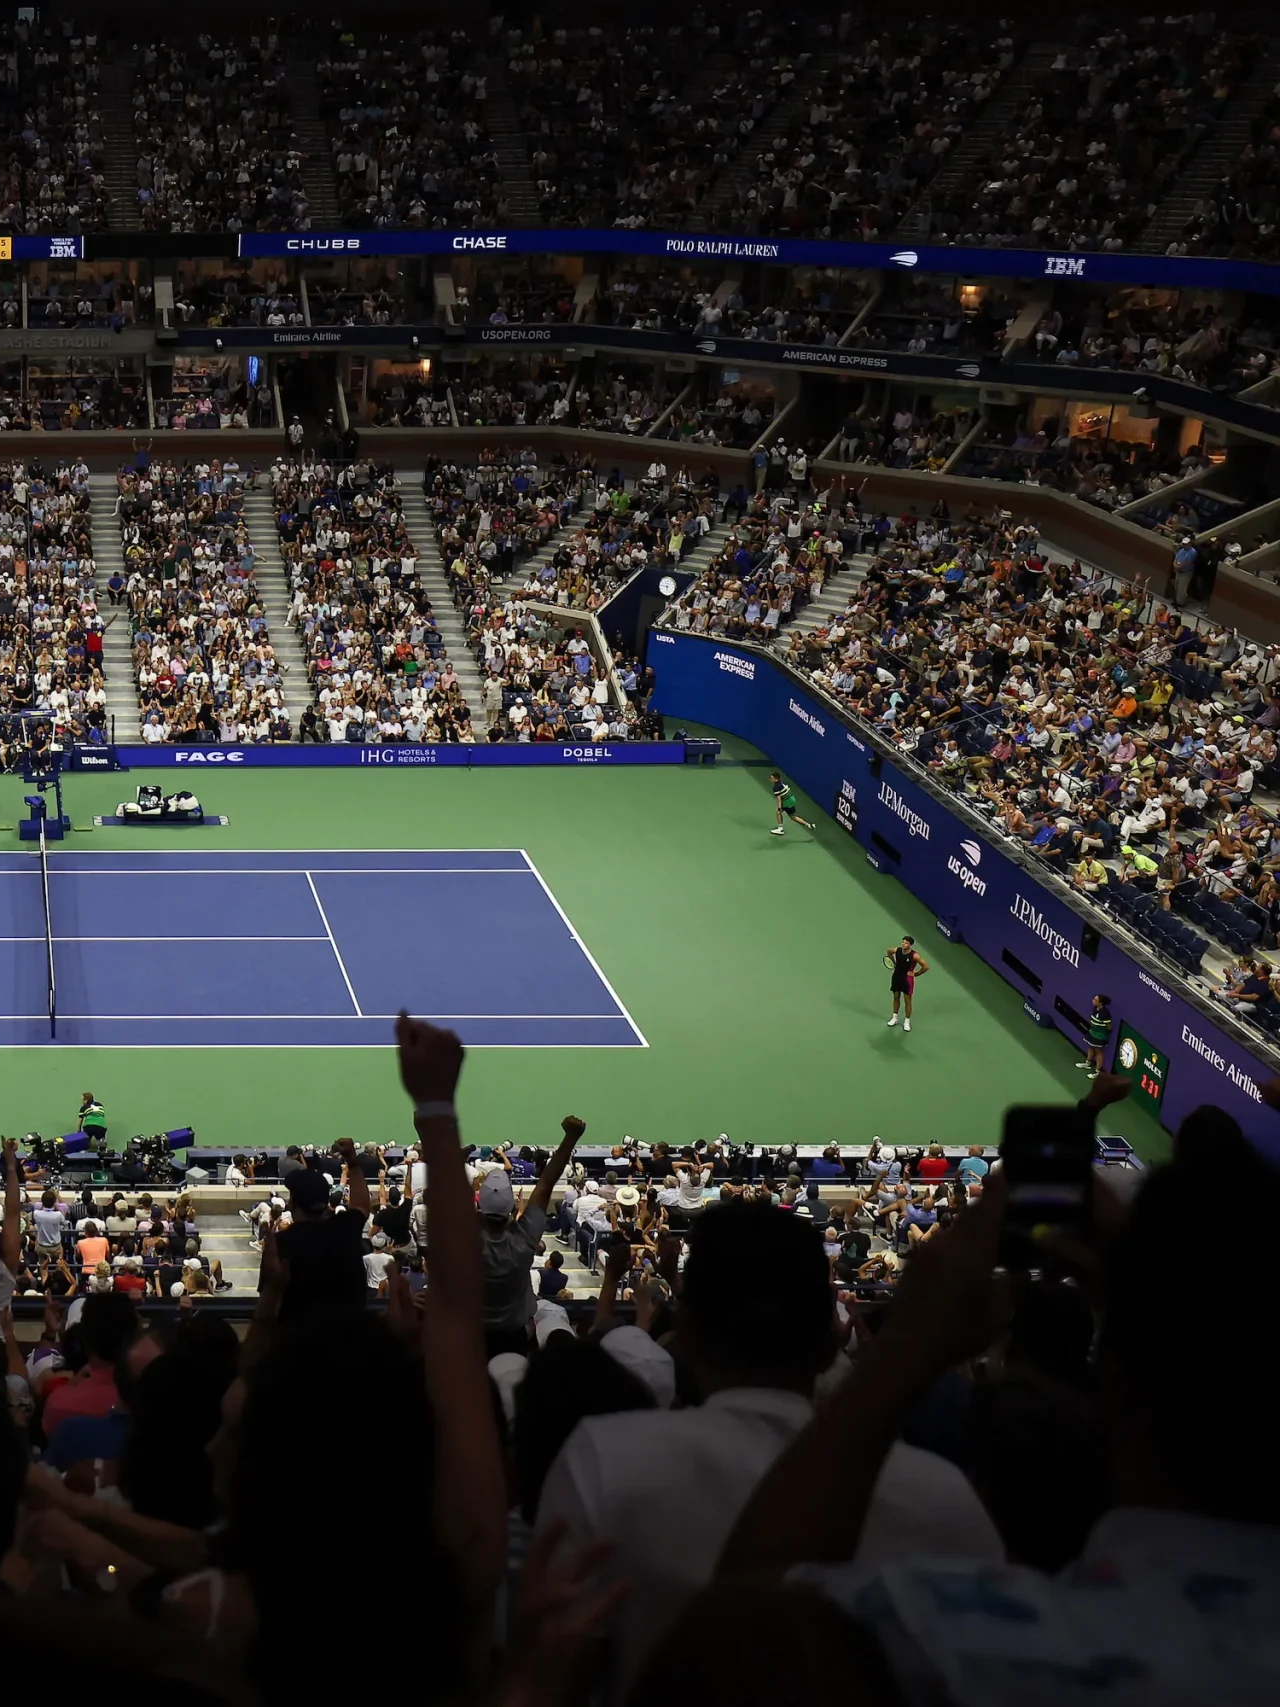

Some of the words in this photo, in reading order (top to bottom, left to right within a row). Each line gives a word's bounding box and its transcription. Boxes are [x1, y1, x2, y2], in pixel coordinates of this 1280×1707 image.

[287, 239, 360, 250] CHUBB
[452, 236, 506, 249] CHASE
[666, 240, 694, 253] POLO
[697, 241, 732, 255] RALPH
[734, 242, 779, 257] LAUREN
[0, 250, 6, 258] 6
[50, 246, 76, 258] IBM
[1044, 256, 1086, 276] IBM
[5, 336, 44, 348] ASHE
[48, 336, 111, 348] STADIUM
[274, 332, 310, 342] Emirates
[312, 332, 342, 342] Airline
[481, 330, 551, 340] USOPEN.ORG
[782, 350, 836, 363] AMERICAN
[839, 355, 888, 368] EXPRESS
[656, 634, 676, 644] USTA
[714, 652, 754, 672] AMERICAN
[720, 662, 754, 680] EXPRESS
[789, 698, 810, 724] Emirates
[809, 714, 826, 737] Airline
[81, 756, 108, 764] Wilson
[176, 752, 244, 762] FAGE
[361, 750, 394, 763] IHG
[563, 748, 612, 757] DOBEL
[838, 796, 850, 816] 120
[878, 780, 930, 840] J.P.Morgan
[948, 855, 960, 875] us
[960, 867, 986, 897] open
[1010, 893, 1080, 968] J.P.Morgan
[1138, 970, 1172, 1002] USOPEN.ORG
[1181, 1024, 1226, 1072] Emirates
[1143, 1058, 1162, 1078] ROLEX
